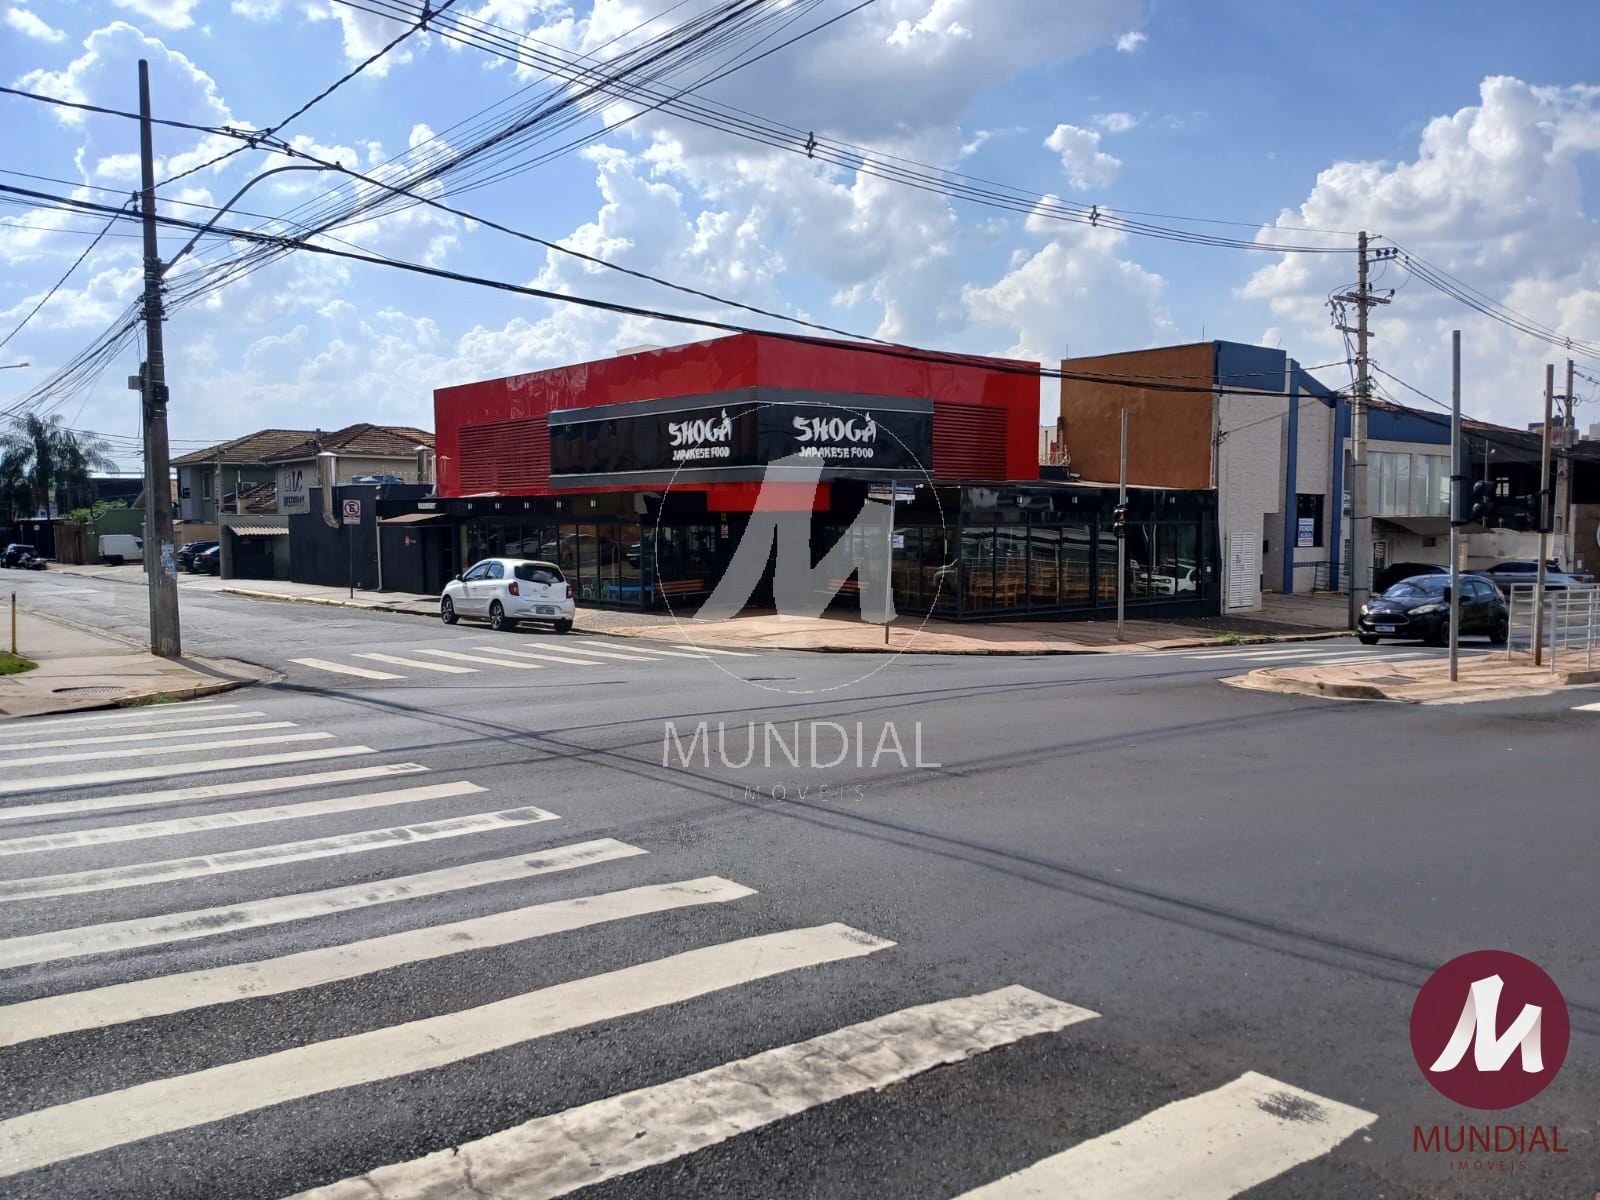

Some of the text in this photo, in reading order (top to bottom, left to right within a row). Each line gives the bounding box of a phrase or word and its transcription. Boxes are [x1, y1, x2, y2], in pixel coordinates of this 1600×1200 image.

[711, 447, 730, 458] FOOD
[798, 446, 873, 459] JAPANESE FOOD
